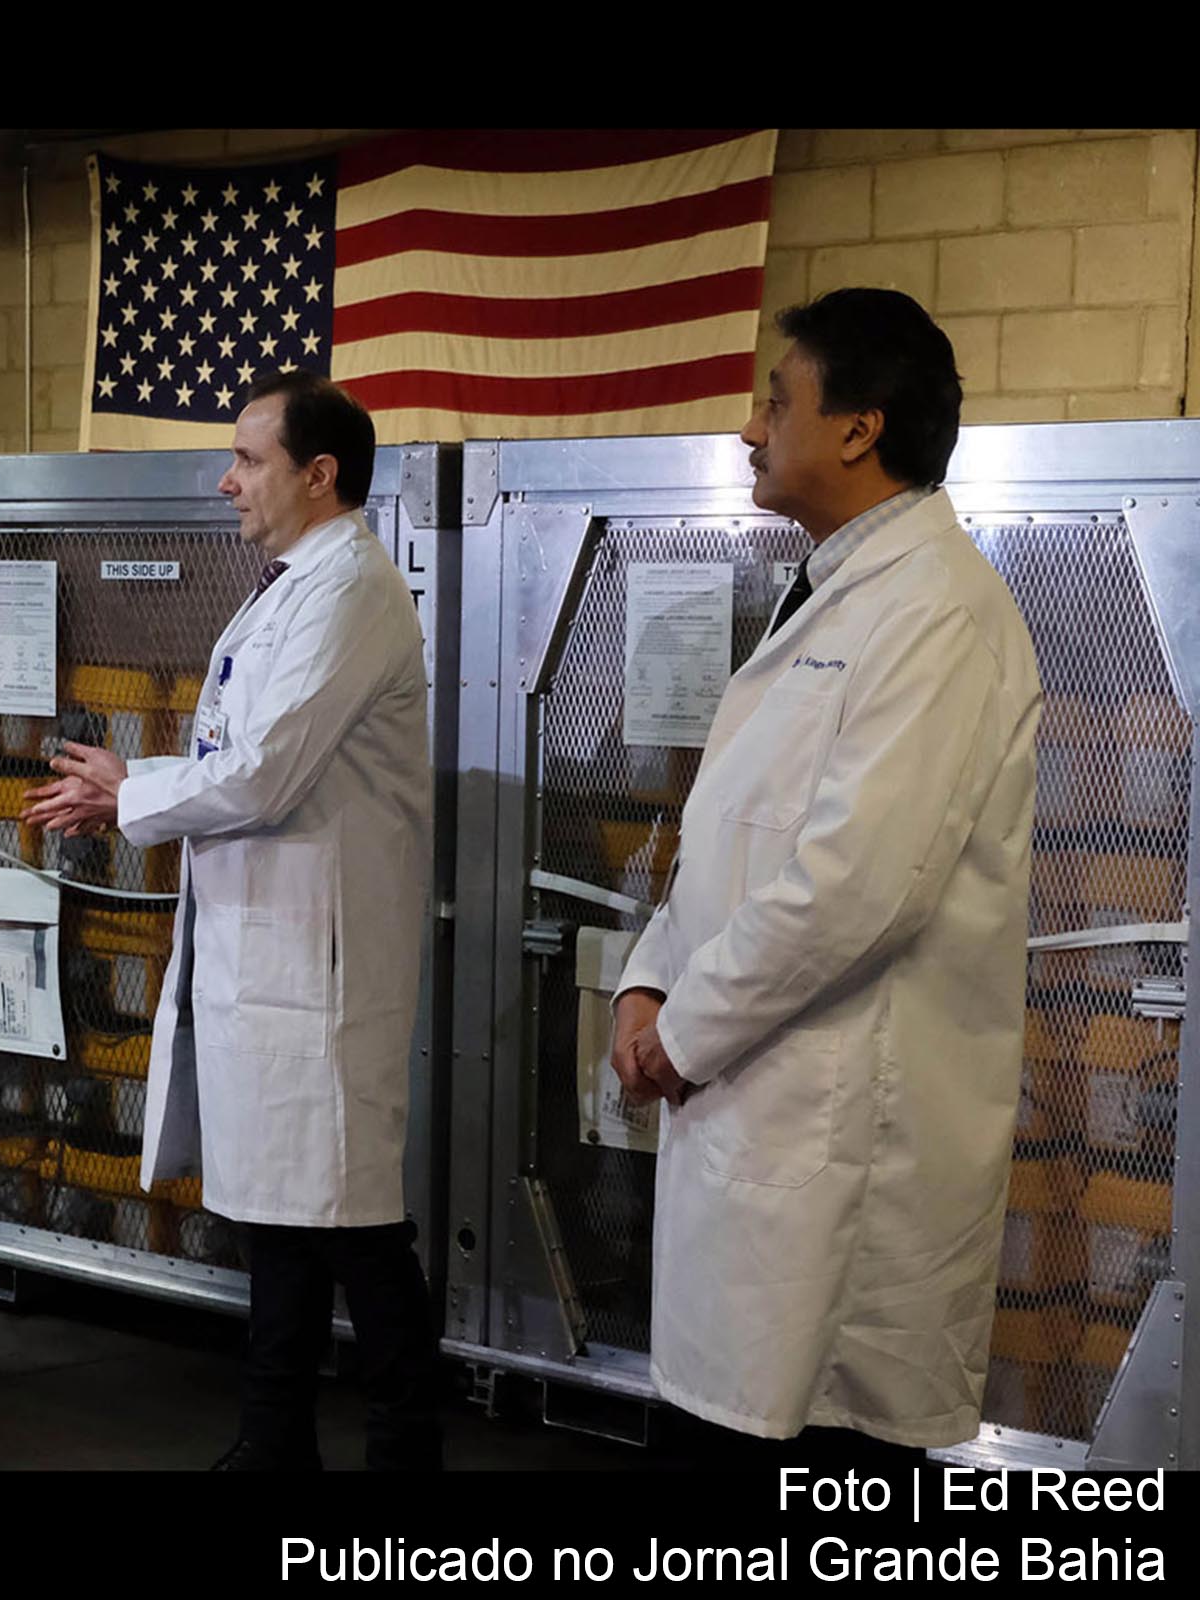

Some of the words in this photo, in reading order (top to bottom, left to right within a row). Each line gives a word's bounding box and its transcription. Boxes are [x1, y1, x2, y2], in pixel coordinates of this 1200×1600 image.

[106, 563, 129, 576] THIS
[131, 563, 156, 576] SIDE
[159, 563, 174, 576] UP
